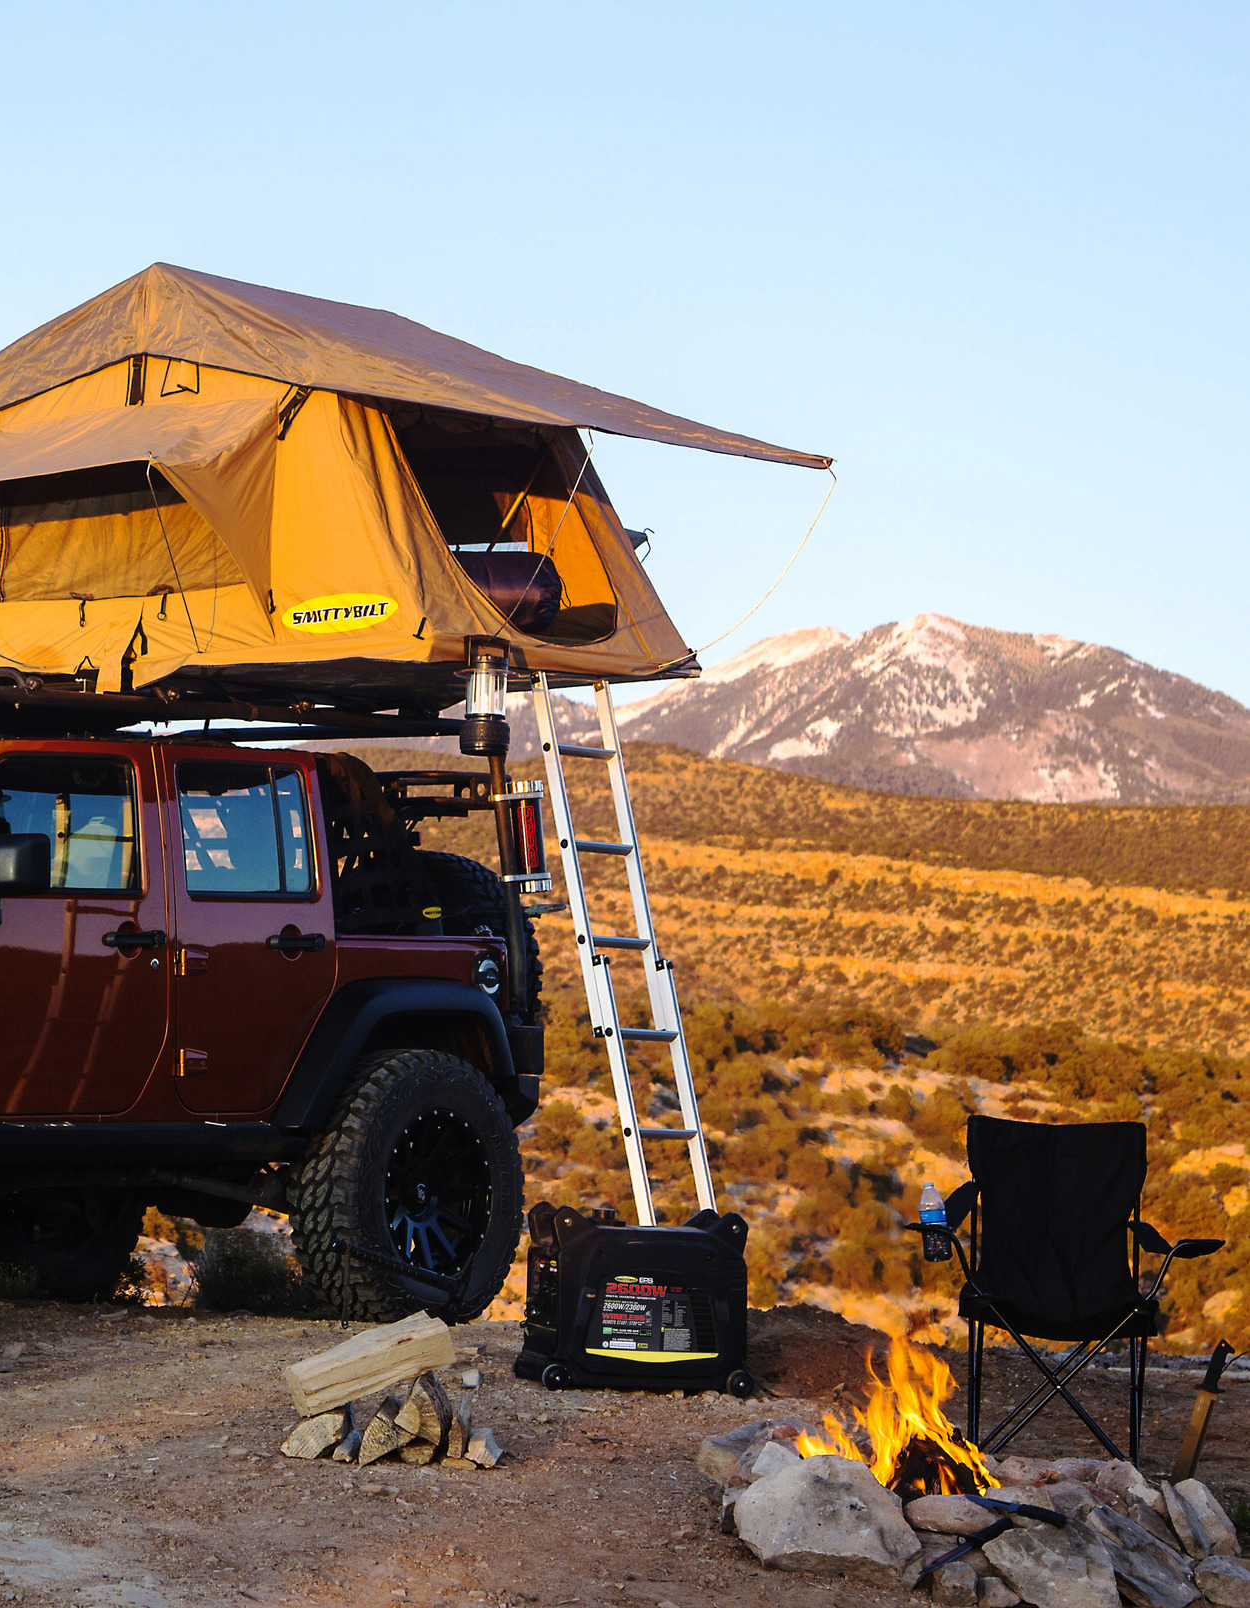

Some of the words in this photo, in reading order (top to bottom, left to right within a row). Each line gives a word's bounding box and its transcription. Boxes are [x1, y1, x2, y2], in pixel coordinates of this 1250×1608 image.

[292, 602, 389, 625] SMITTYBILT
[606, 1283, 667, 1297] 2600W
[602, 1312, 645, 1322] WIRELESS
